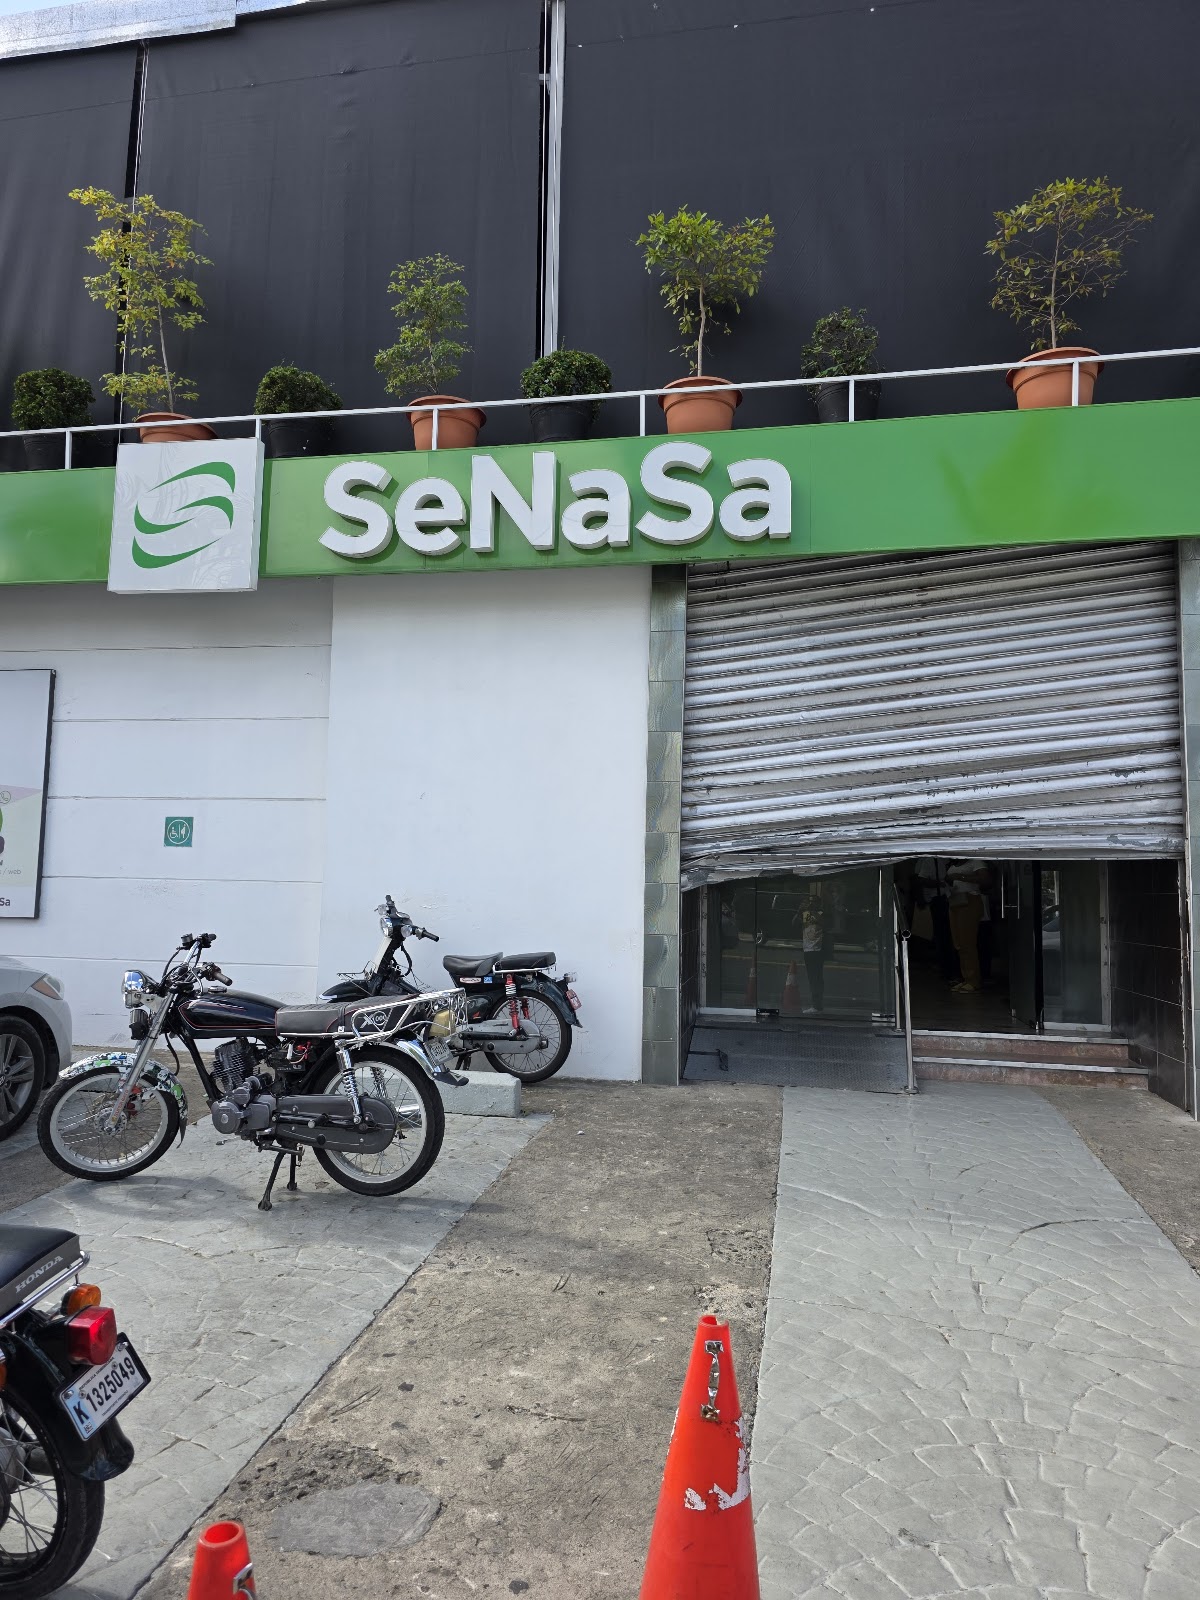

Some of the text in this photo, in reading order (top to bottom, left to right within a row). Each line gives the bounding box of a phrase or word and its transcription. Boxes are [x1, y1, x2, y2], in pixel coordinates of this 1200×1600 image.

[318, 441, 792, 559] SeNaSa
[15, 1255, 64, 1293] HONDA
[73, 1400, 90, 1425] K
[86, 1356, 136, 1413] 1325049
